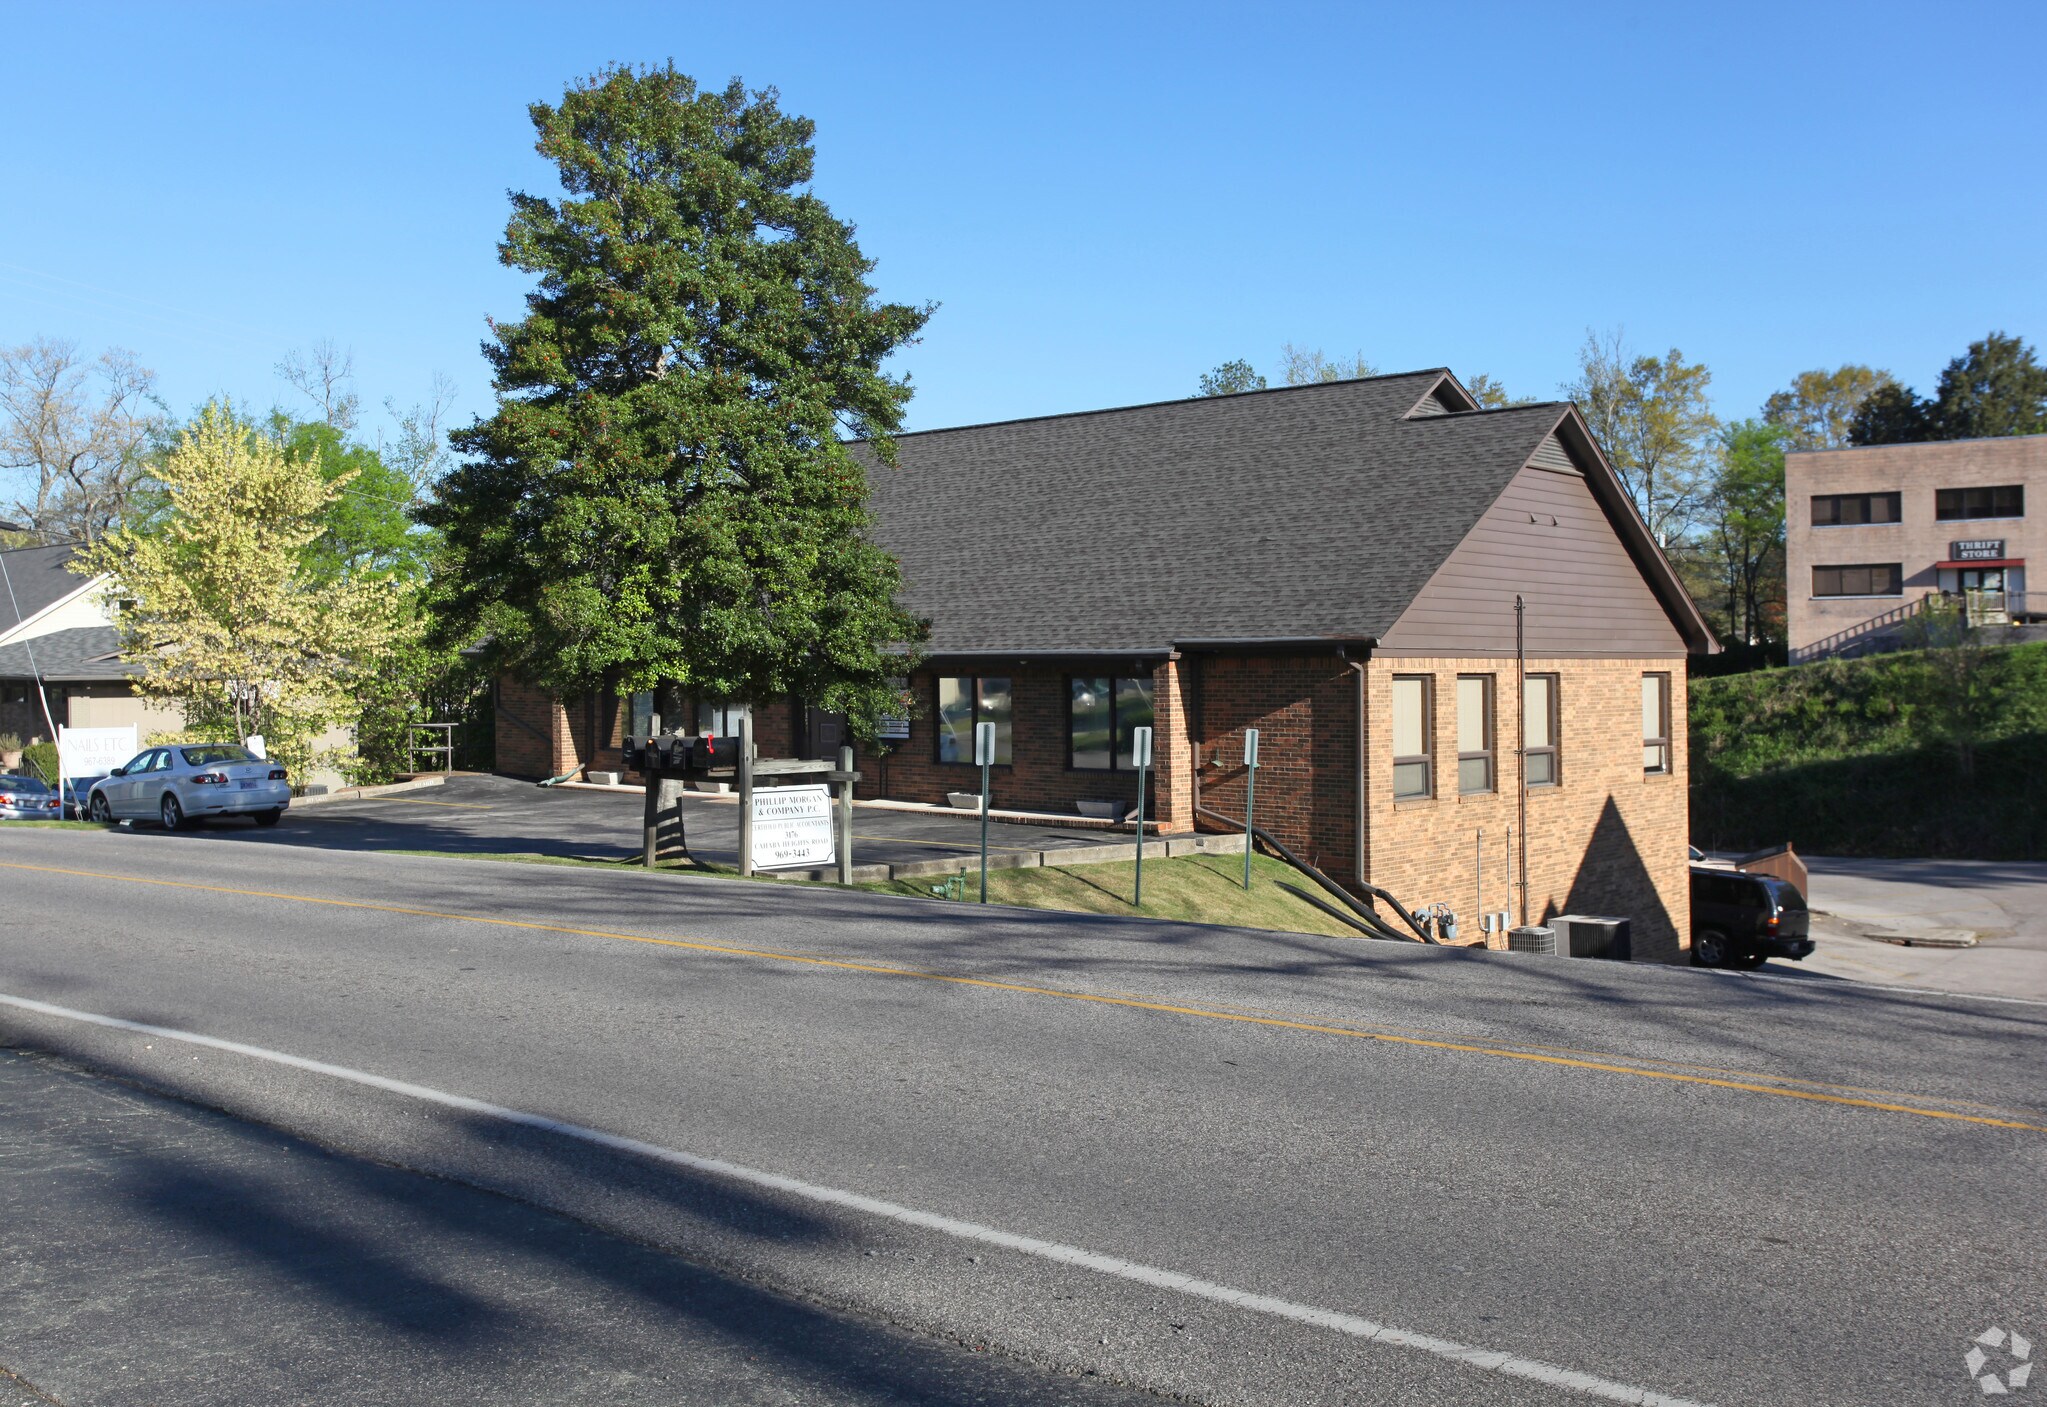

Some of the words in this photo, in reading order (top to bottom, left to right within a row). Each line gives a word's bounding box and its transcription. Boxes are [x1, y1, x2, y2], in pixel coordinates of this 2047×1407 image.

[1958, 541, 2000, 550] THRIFT
[1961, 550, 1998, 558] STORE
[67, 738, 99, 752] NAILS
[104, 737, 128, 752] ETC
[754, 797, 787, 806] PHILLIP
[789, 795, 822, 804] MORGAN
[766, 806, 804, 816] COMPANY
[807, 805, 821, 813] P.C.
[778, 821, 795, 830] PUBLIC
[796, 820, 830, 828] ACCOUNTANTS
[785, 830, 798, 840] 3176
[754, 841, 781, 850] CAHABA
[782, 838, 810, 848] HEIGHTS
[774, 848, 810, 859] 969-3443
